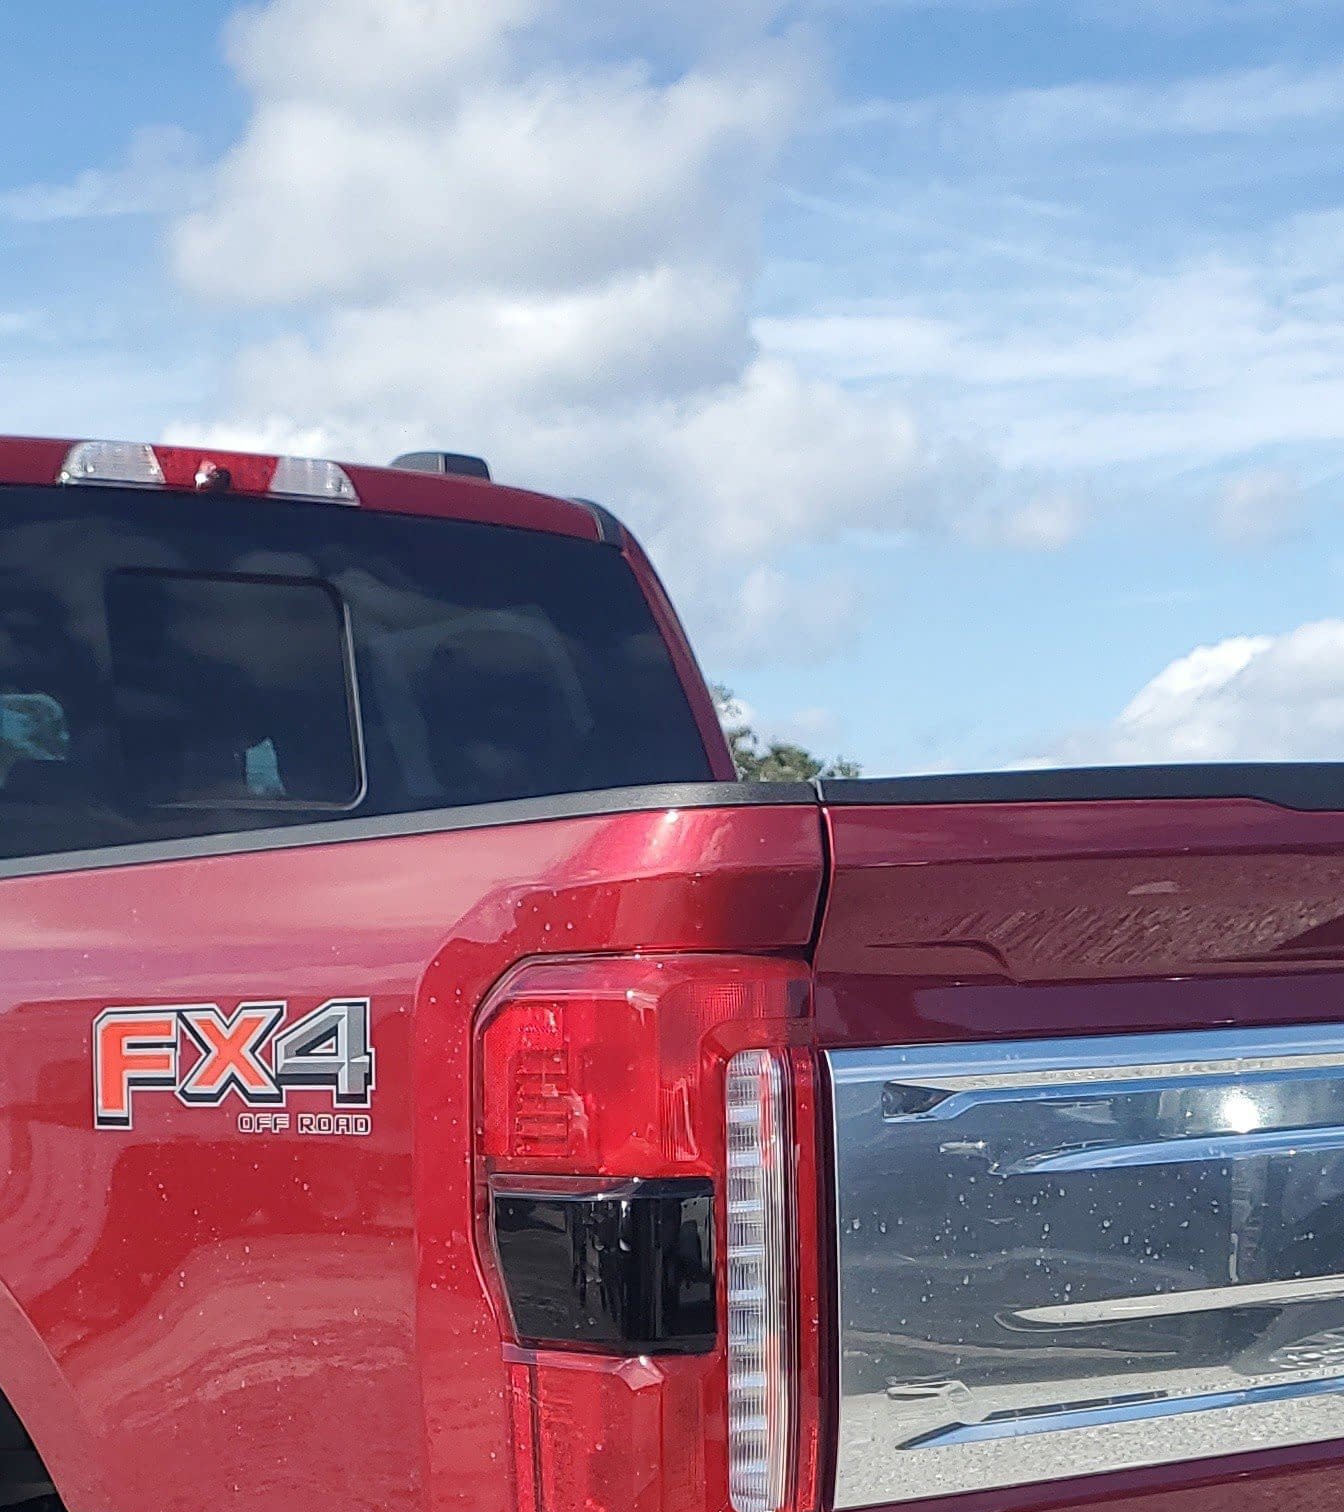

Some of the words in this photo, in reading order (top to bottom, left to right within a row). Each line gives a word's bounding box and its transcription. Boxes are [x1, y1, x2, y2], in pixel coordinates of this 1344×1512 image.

[93, 997, 375, 1130] FX4
[238, 1113, 290, 1133] OFF
[297, 1113, 371, 1136] ROAD
